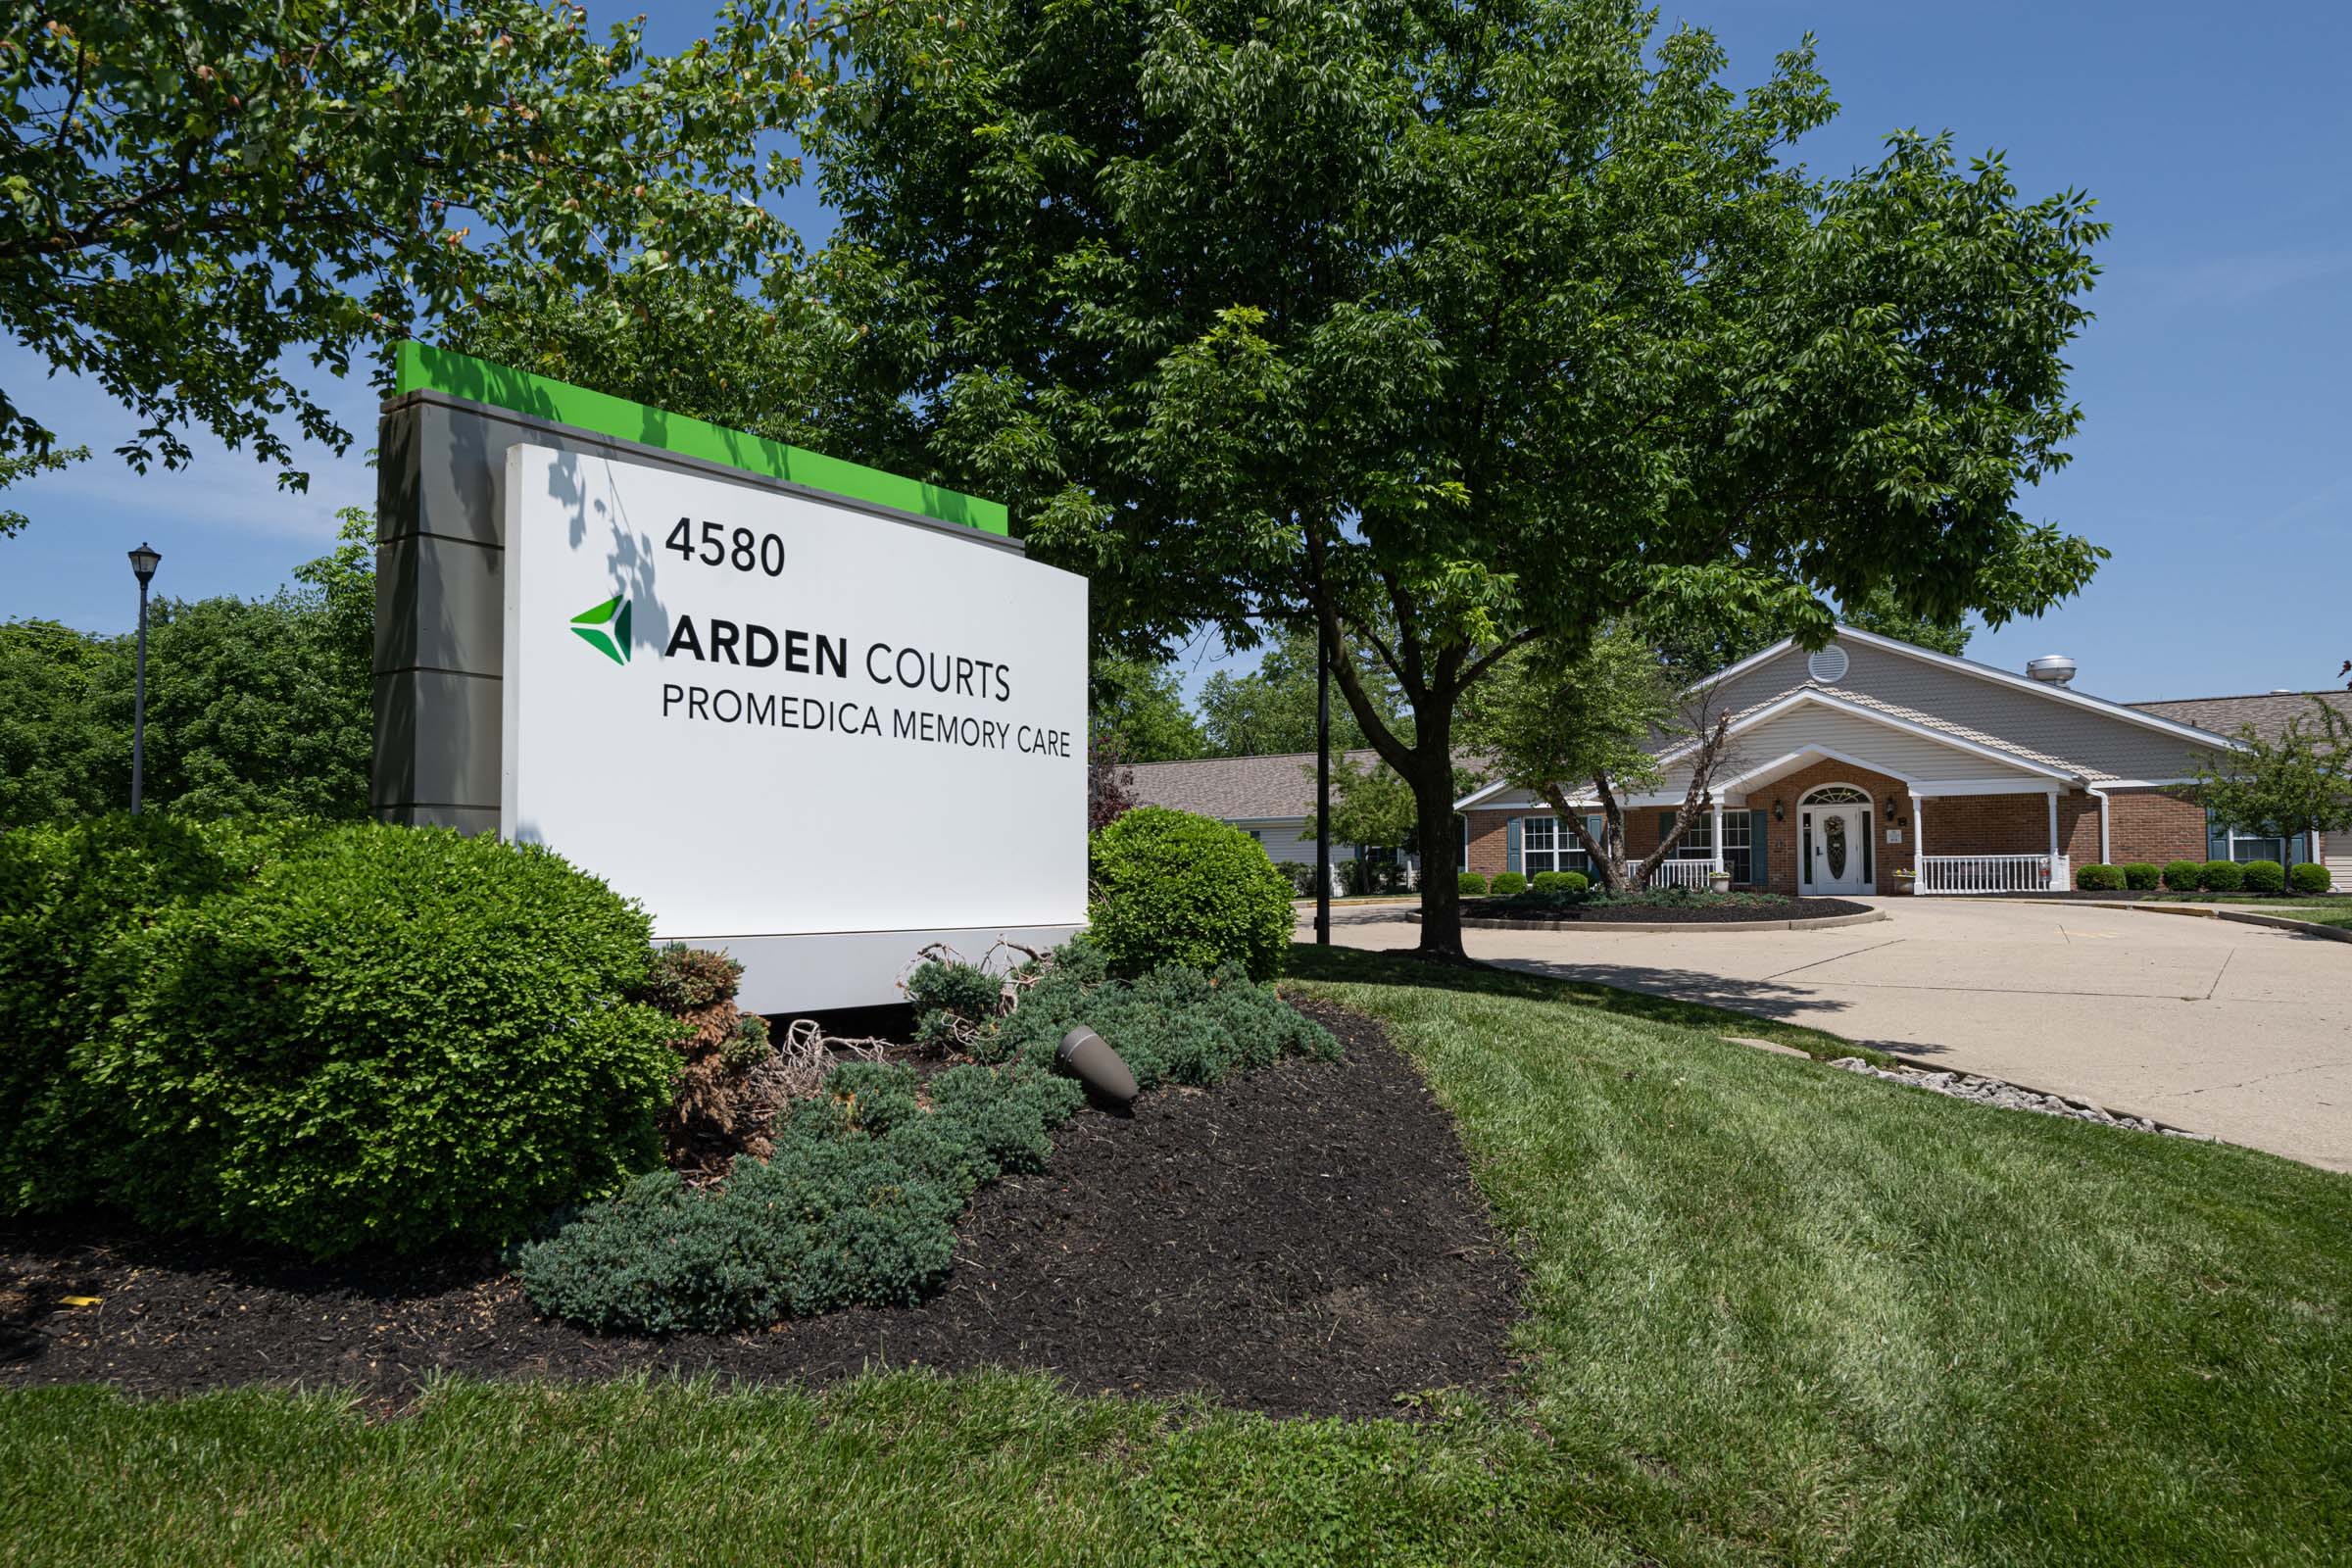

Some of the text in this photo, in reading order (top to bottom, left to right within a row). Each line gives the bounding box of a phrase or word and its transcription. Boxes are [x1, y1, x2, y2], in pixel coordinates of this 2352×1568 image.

[665, 516, 785, 577] 4580
[664, 614, 1010, 703] ARDEN COURTS
[662, 683, 1071, 758] PROMEDICA MEMORY CARE
